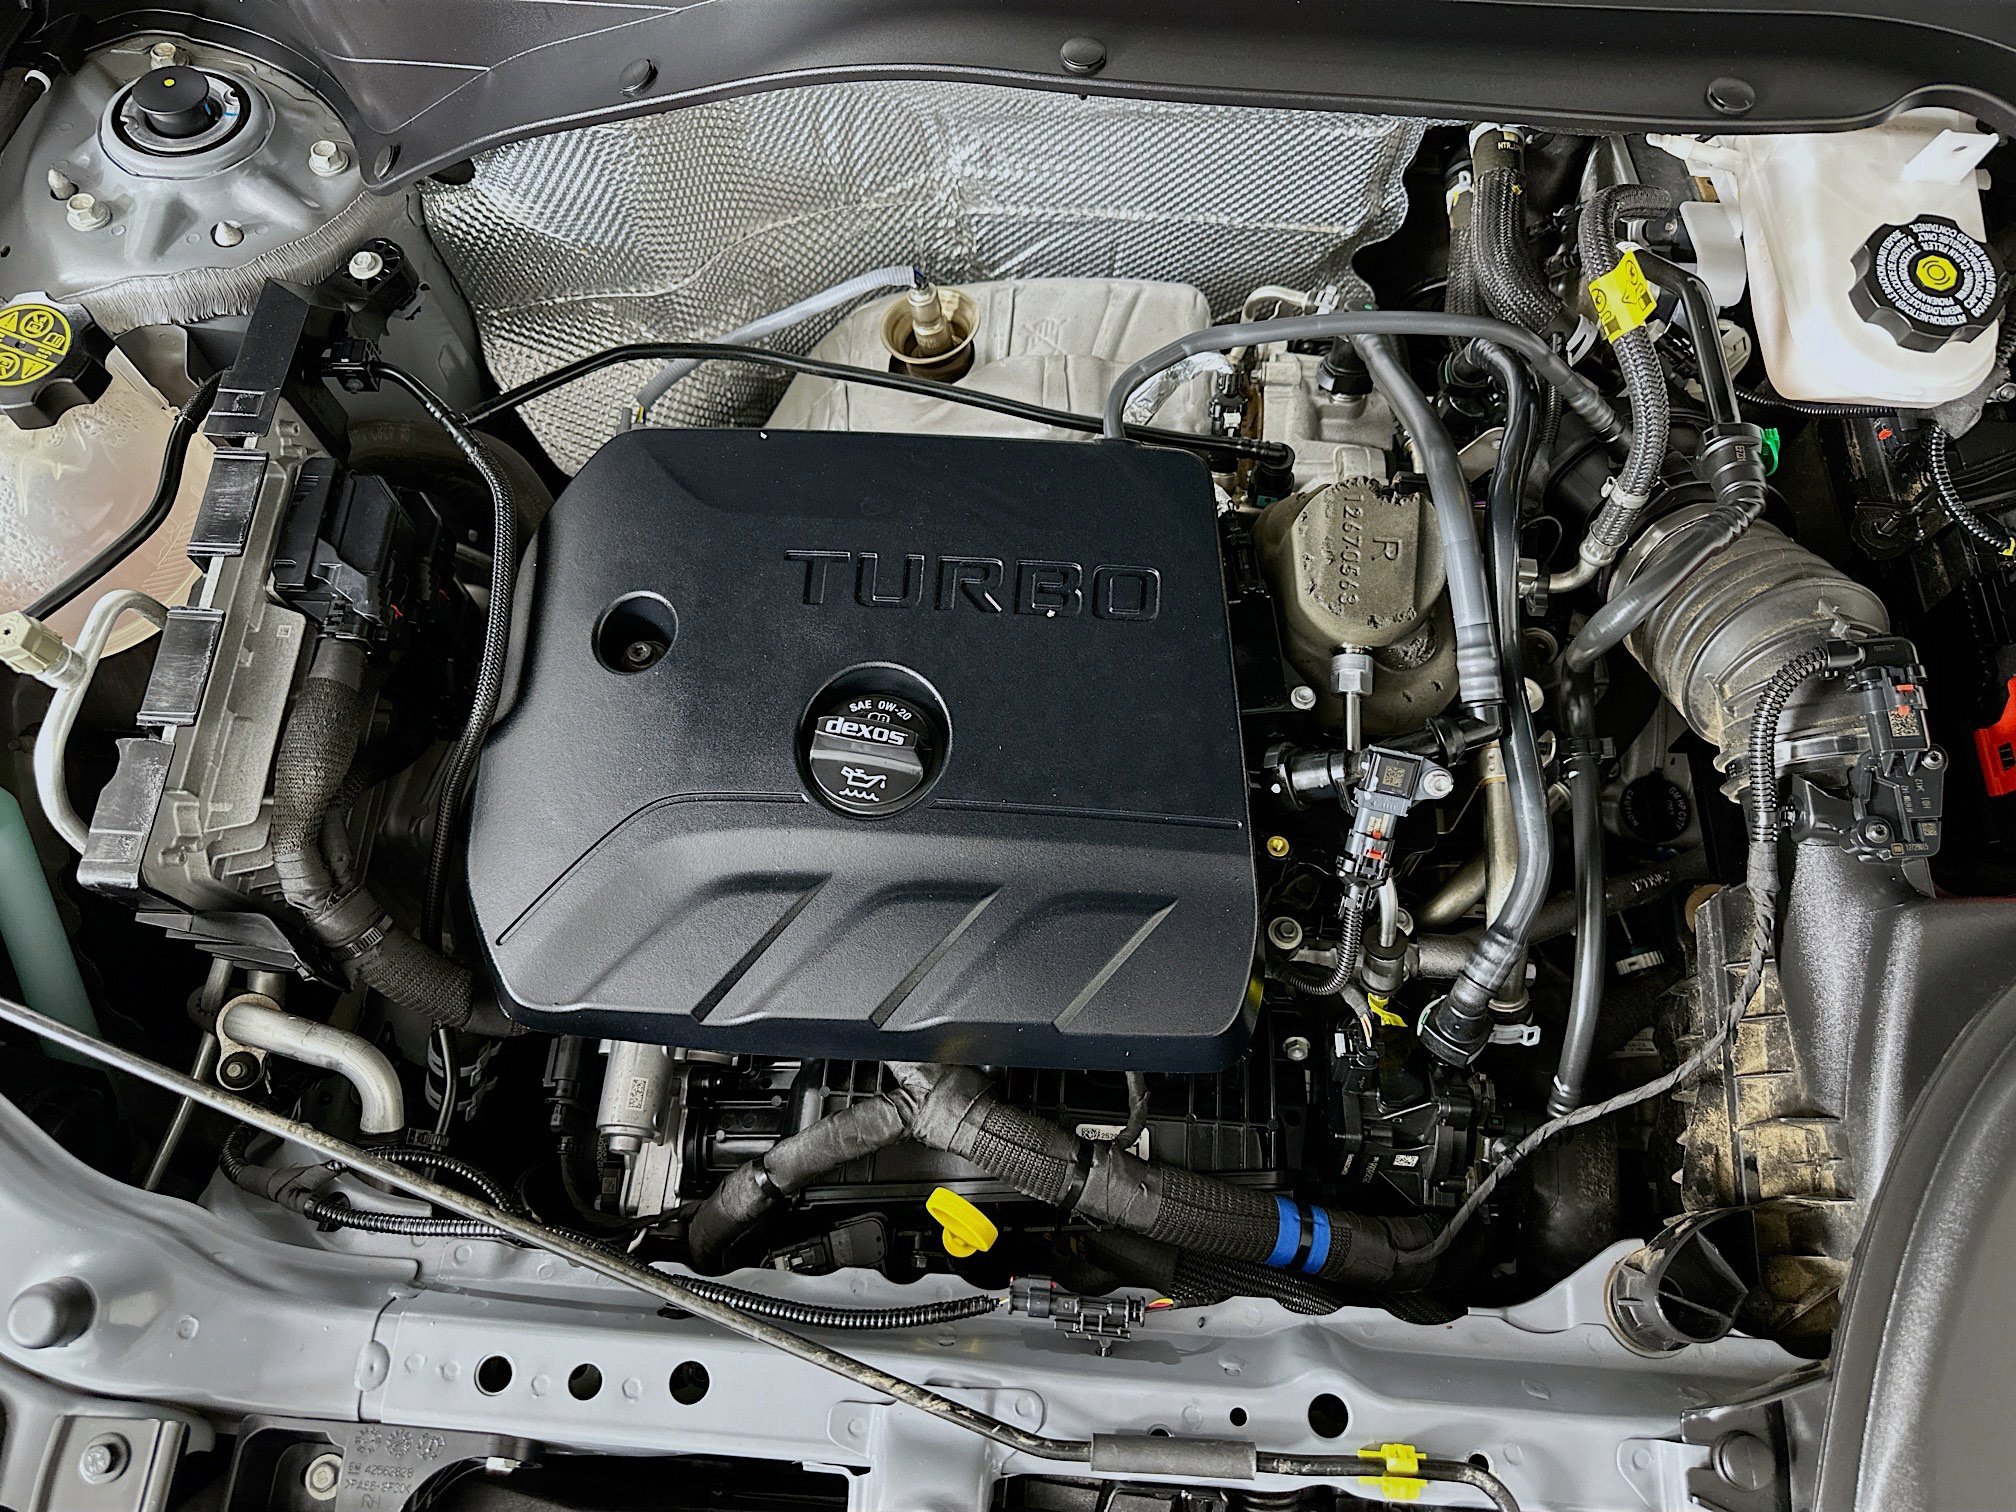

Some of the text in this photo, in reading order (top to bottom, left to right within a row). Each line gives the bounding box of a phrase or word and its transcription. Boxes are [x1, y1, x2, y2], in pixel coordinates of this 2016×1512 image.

[1896, 237, 1910, 250] DOT
[1918, 232, 1938, 241] ONLY
[1938, 234, 1954, 246] USE
[1957, 233, 1984, 256] SEALED
[1876, 247, 1889, 267] AVANT
[1888, 246, 1902, 263] FREIN
[1948, 248, 1970, 269] CLEAN
[1876, 266, 1894, 294] BOUCHON
[1981, 260, 1996, 281] FROM
[1888, 270, 1905, 294] LIQUIDE
[1972, 271, 1985, 298] BEFORE
[1983, 281, 1996, 303] FLUID
[1907, 296, 1922, 308] QUE
[1915, 291, 1954, 306] PROVENANT
[1964, 294, 1978, 309] CAP
[1895, 299, 1929, 322] NETTOYER
[1971, 303, 1987, 317] DOT
[1371, 537, 1402, 561] R
[784, 549, 1161, 623] TURBO
[849, 700, 912, 721] SAE 0W-20
[824, 716, 909, 746] dexos
